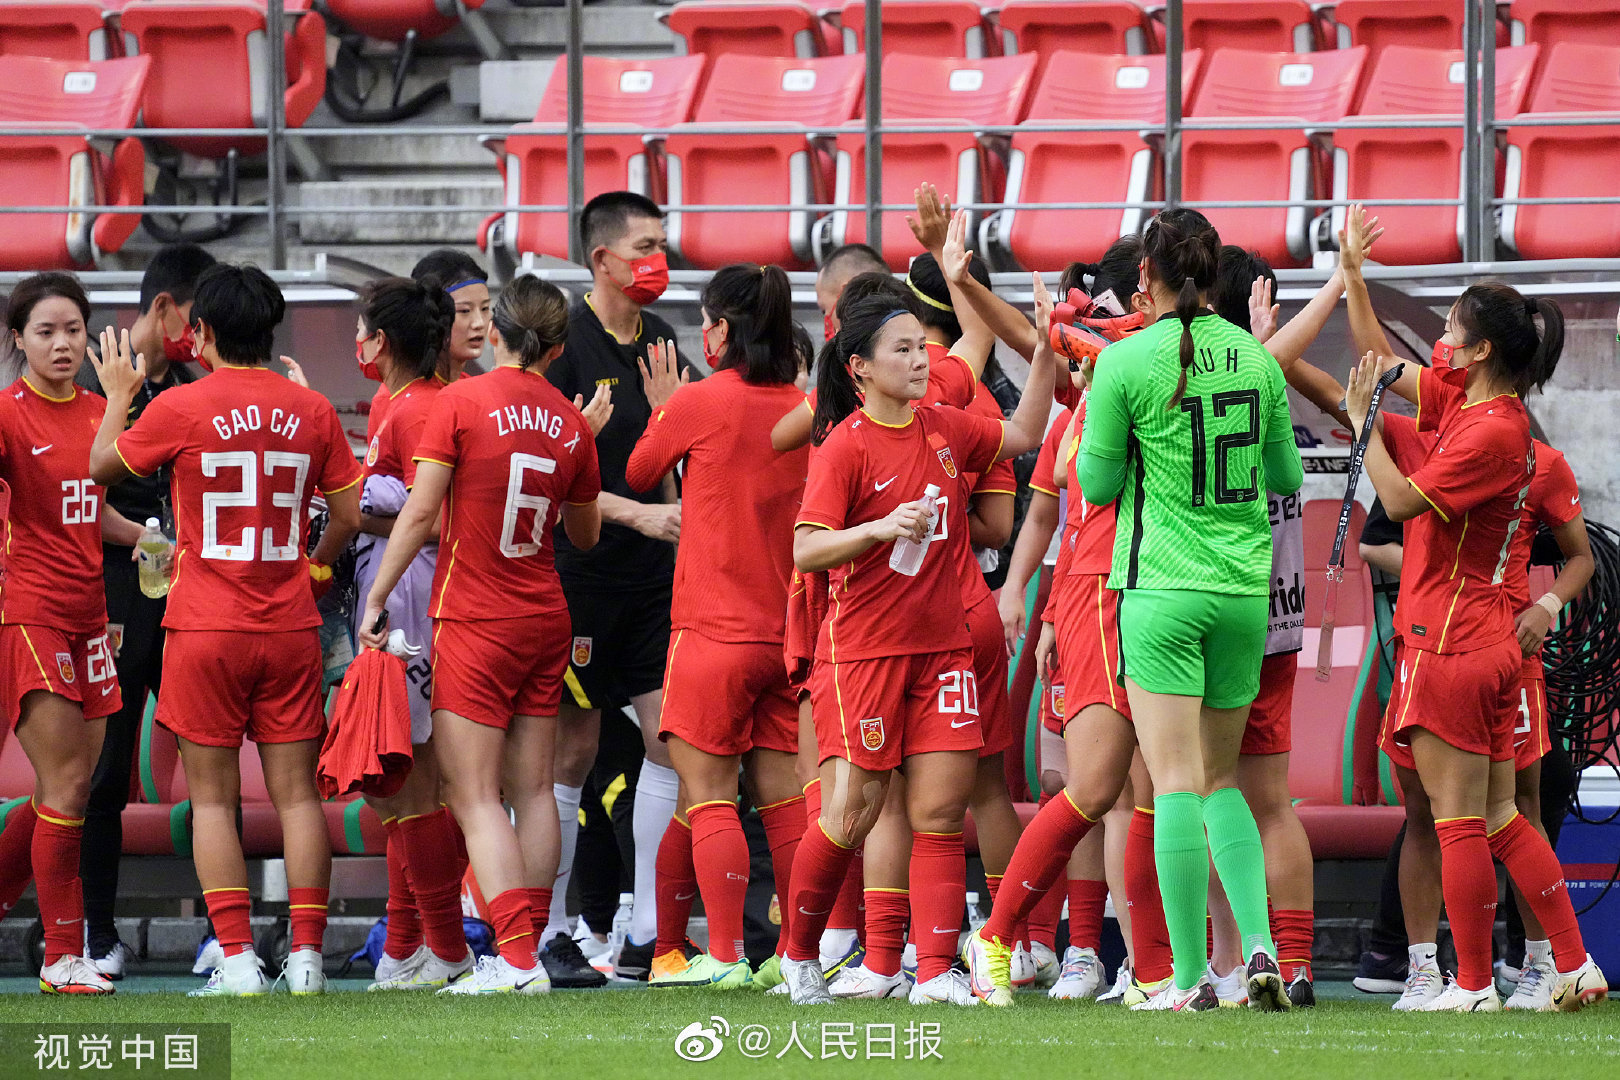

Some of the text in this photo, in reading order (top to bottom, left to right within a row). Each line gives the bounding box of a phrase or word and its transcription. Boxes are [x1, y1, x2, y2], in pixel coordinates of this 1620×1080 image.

[1226, 347, 1238, 373] H
[212, 404, 301, 441] GAO CH
[488, 404, 581, 455] ZHANG X
[1180, 388, 1260, 508] 12
[61, 478, 98, 525] 26
[200, 450, 311, 562] 23
[500, 452, 557, 559] 6
[1268, 572, 1306, 618] rid
[1274, 621, 1289, 631] THE
[938, 669, 980, 717] 20
